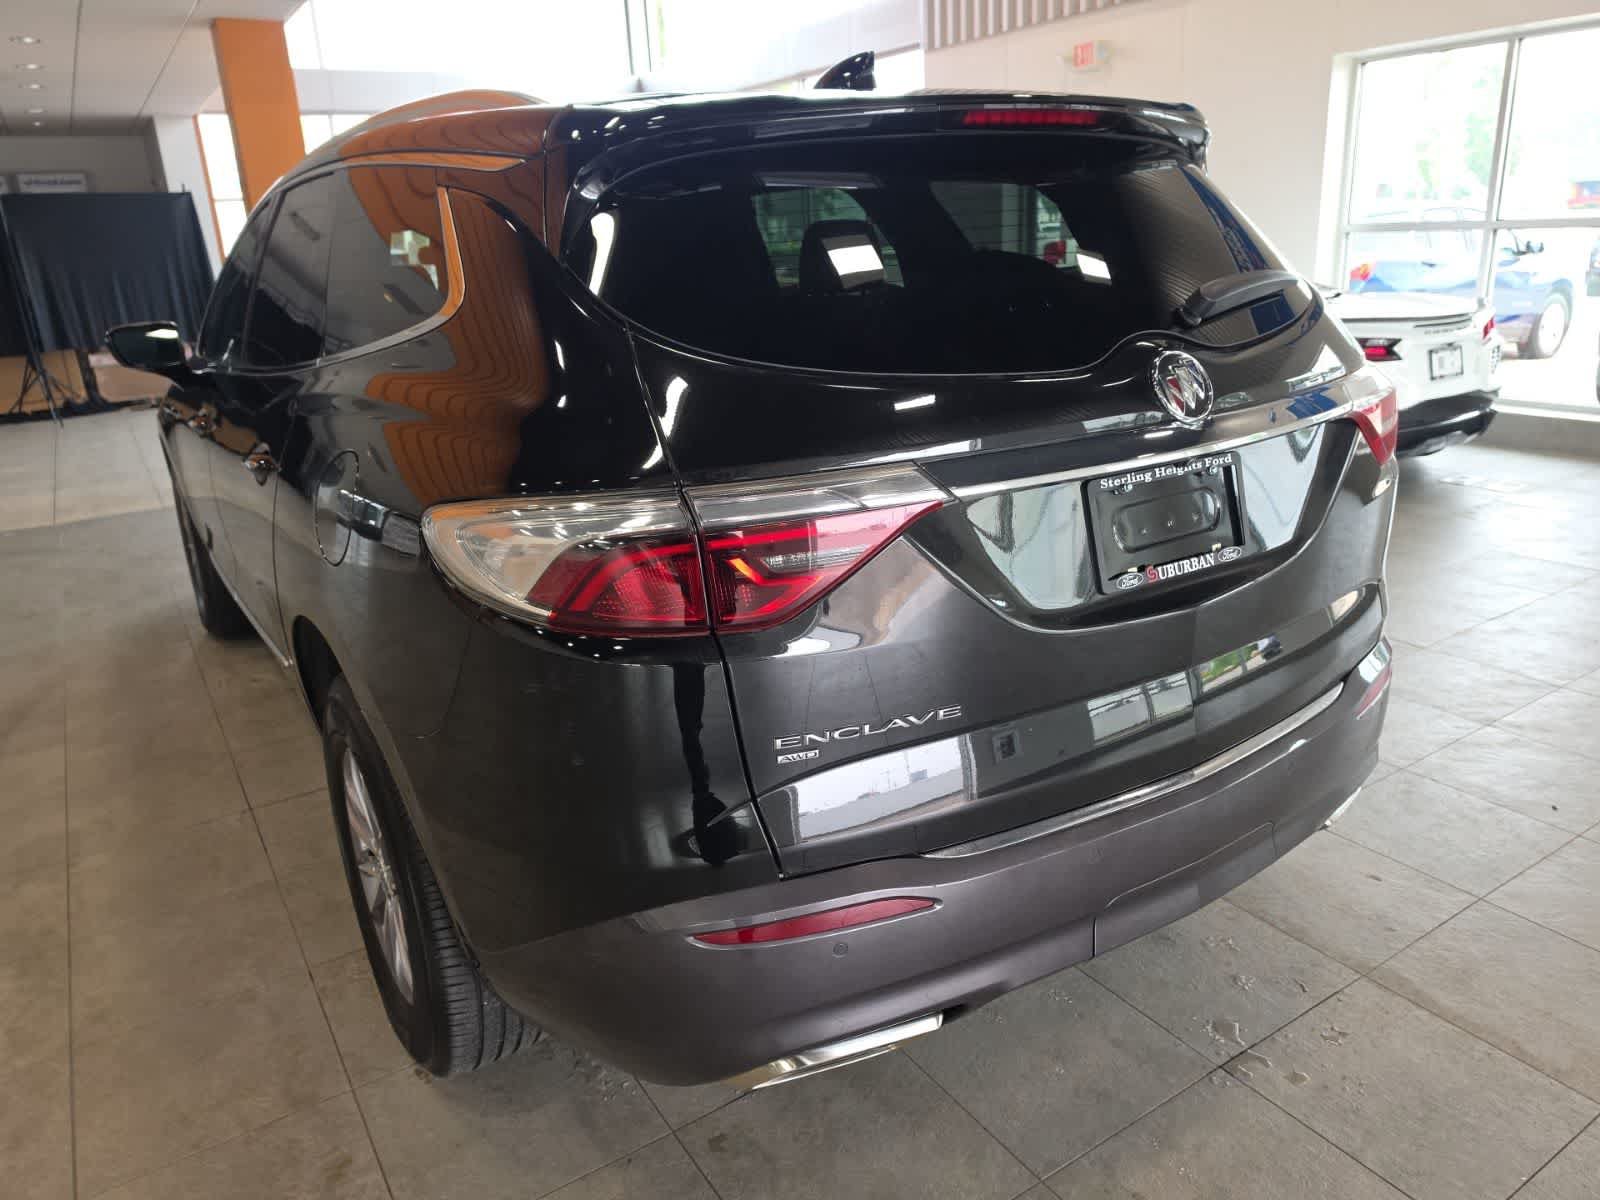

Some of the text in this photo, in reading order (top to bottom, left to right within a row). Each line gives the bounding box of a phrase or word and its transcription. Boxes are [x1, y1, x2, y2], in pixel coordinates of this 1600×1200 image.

[1100, 471, 1152, 489] Sterling
[1205, 453, 1232, 467] Ford
[1146, 553, 1215, 583] SUBURBAN
[774, 704, 962, 750] ENCLAVE
[778, 750, 820, 764] AWD
